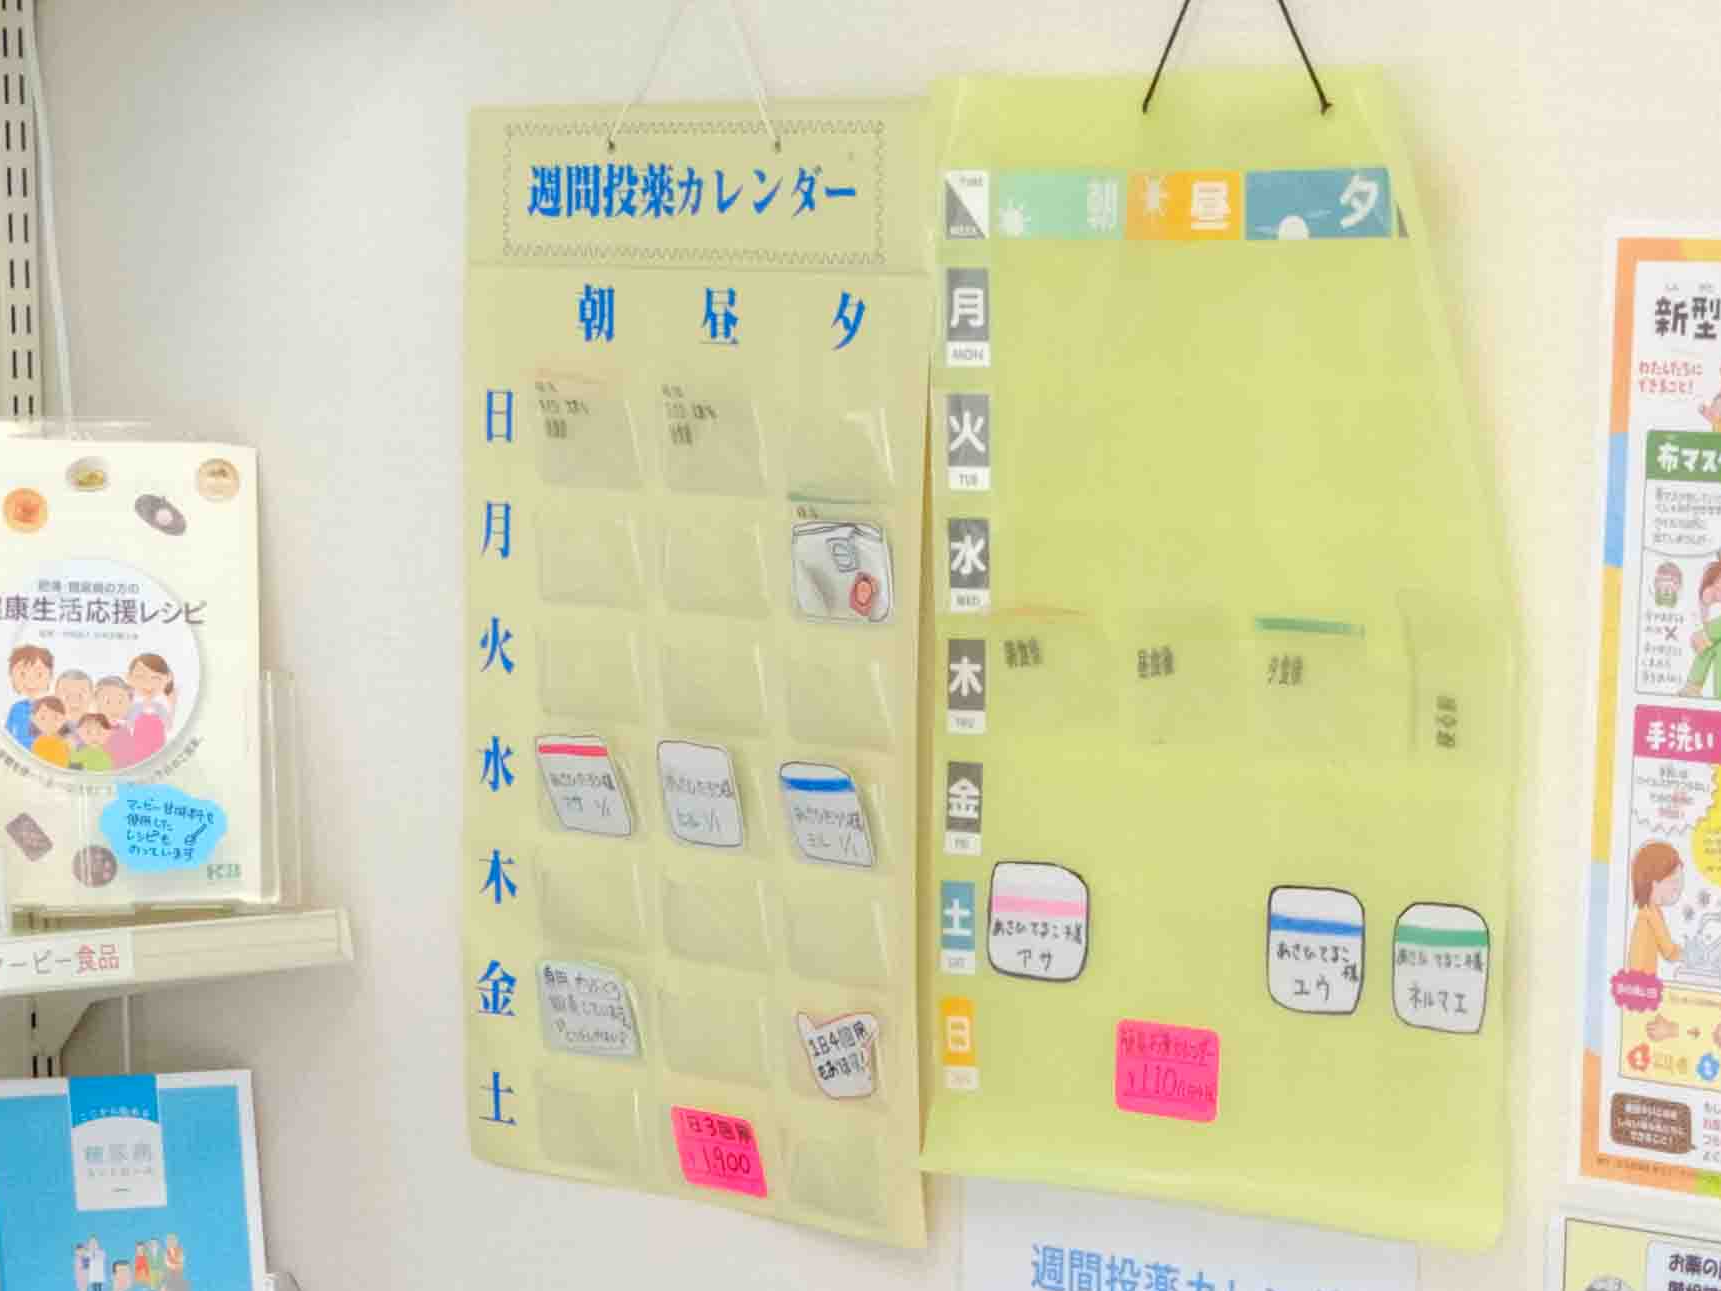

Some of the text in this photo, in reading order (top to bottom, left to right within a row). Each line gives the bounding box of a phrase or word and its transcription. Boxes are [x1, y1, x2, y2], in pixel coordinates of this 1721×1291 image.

[525, 162, 856, 220] 週間投薬カレンダー
[1188, 178, 1233, 232] 昼
[1339, 173, 1380, 229] 夕
[575, 283, 867, 351] 朝 昼 夕
[949, 285, 987, 328] 月
[485, 388, 515, 444] 日
[948, 410, 987, 453] 火
[482, 500, 513, 560] 月
[949, 534, 988, 576] 水
[479, 616, 517, 674] 火
[947, 656, 984, 697] 木
[1644, 720, 1715, 754] 手洗い
[477, 735, 516, 792] 水
[947, 776, 980, 820] 金
[477, 849, 519, 905] 木
[942, 896, 974, 939] 土
[1017, 948, 1056, 975] アサ
[477, 958, 519, 1018] 金
[1291, 976, 1334, 1003] ユウ
[945, 1014, 972, 1051] 日
[478, 1071, 519, 1126] 土
